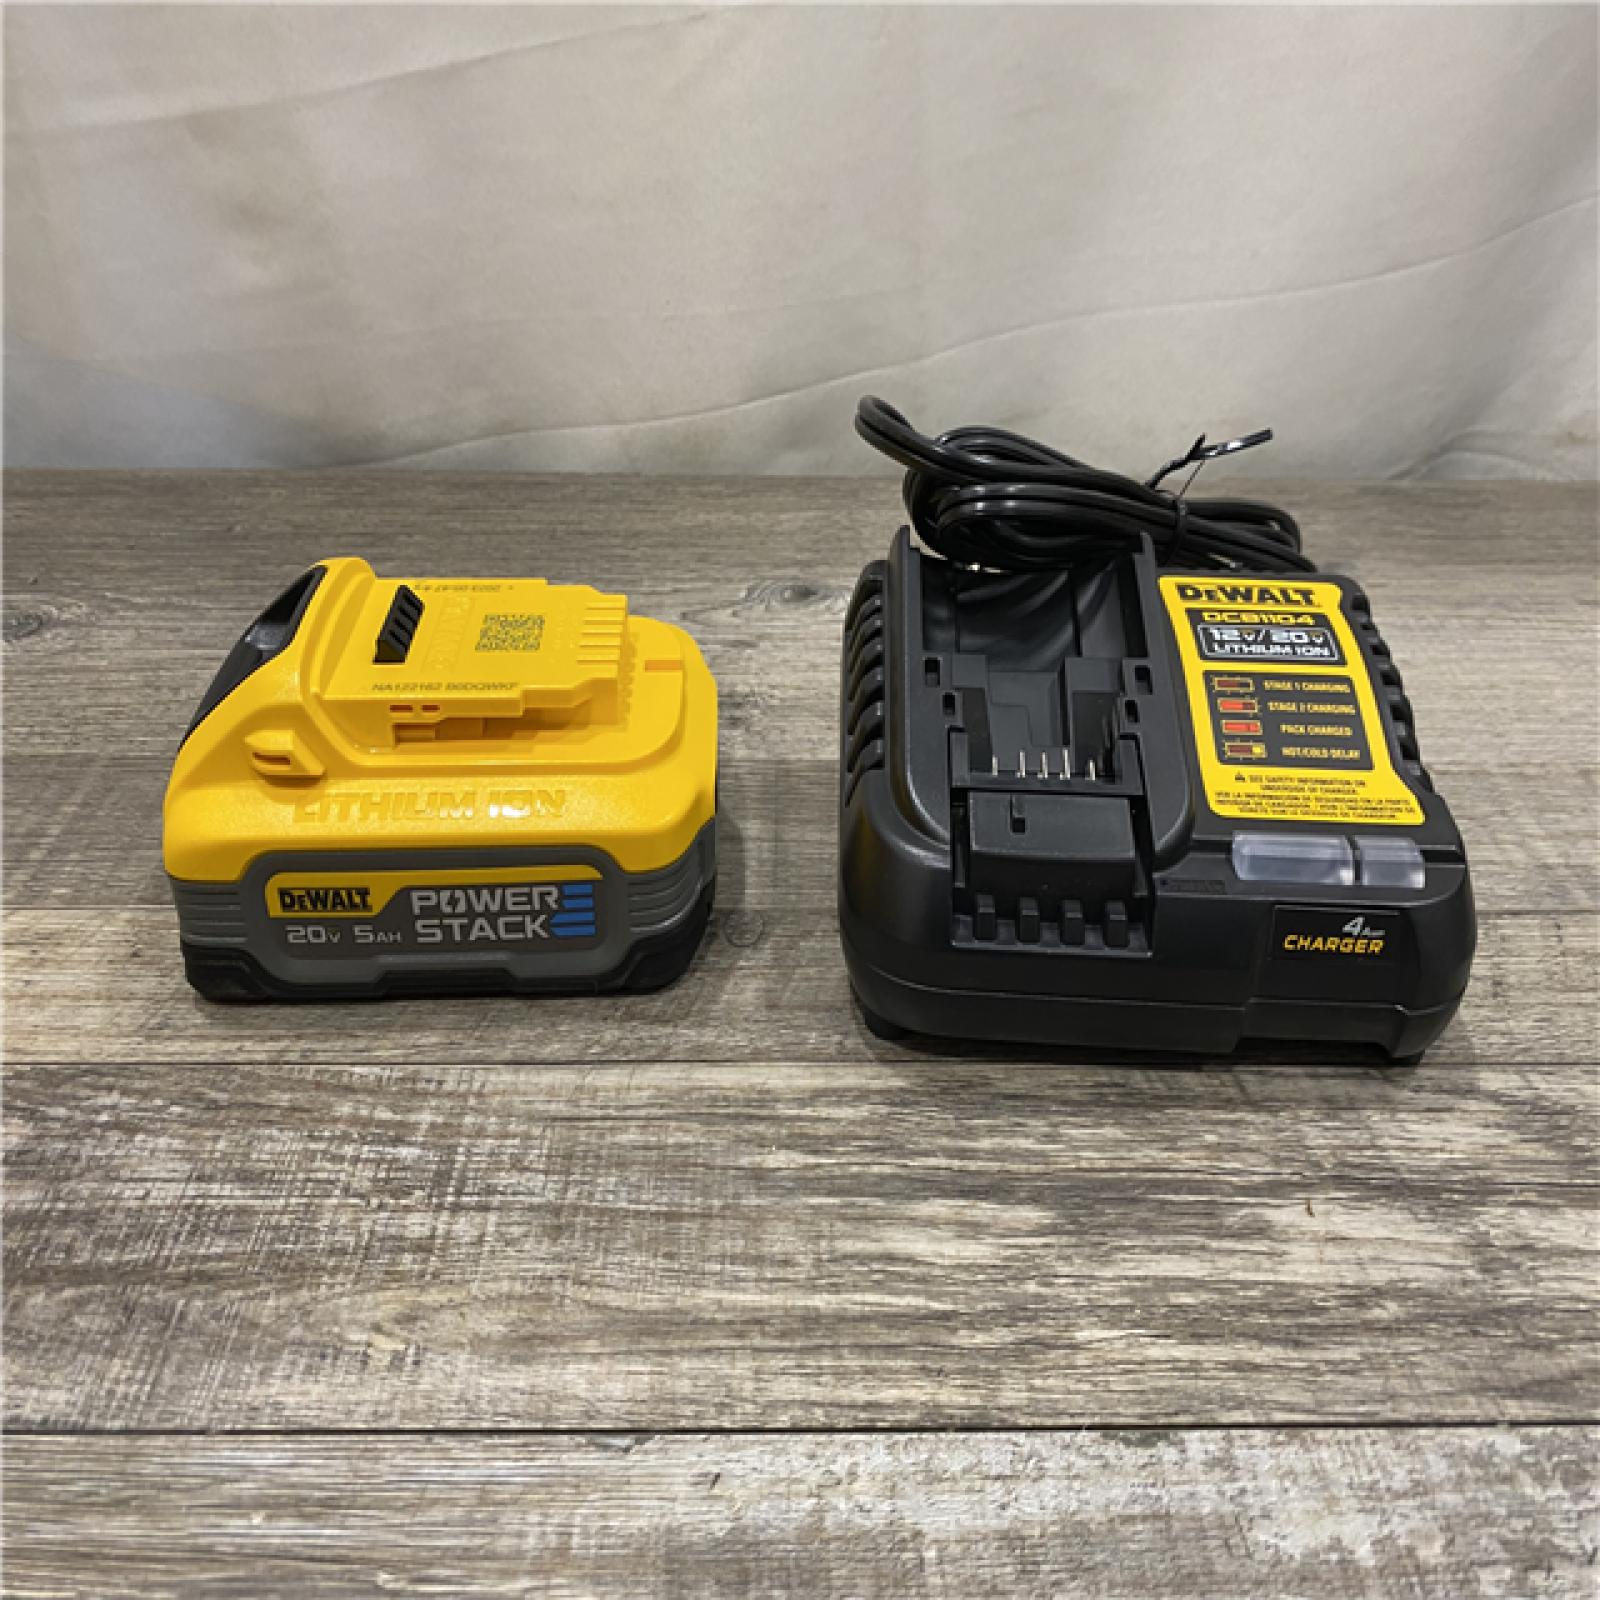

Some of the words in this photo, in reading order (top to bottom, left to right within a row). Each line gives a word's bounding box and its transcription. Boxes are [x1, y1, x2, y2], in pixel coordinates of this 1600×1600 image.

[1214, 643, 1293, 656] LITHIUM
[1295, 646, 1332, 657] ION
[294, 789, 476, 823] LITHIUM
[488, 789, 567, 818] ION
[410, 884, 559, 915] POWER
[415, 914, 550, 943] STACK
[1342, 916, 1366, 936] 4
[1284, 934, 1386, 954] CHARGER
